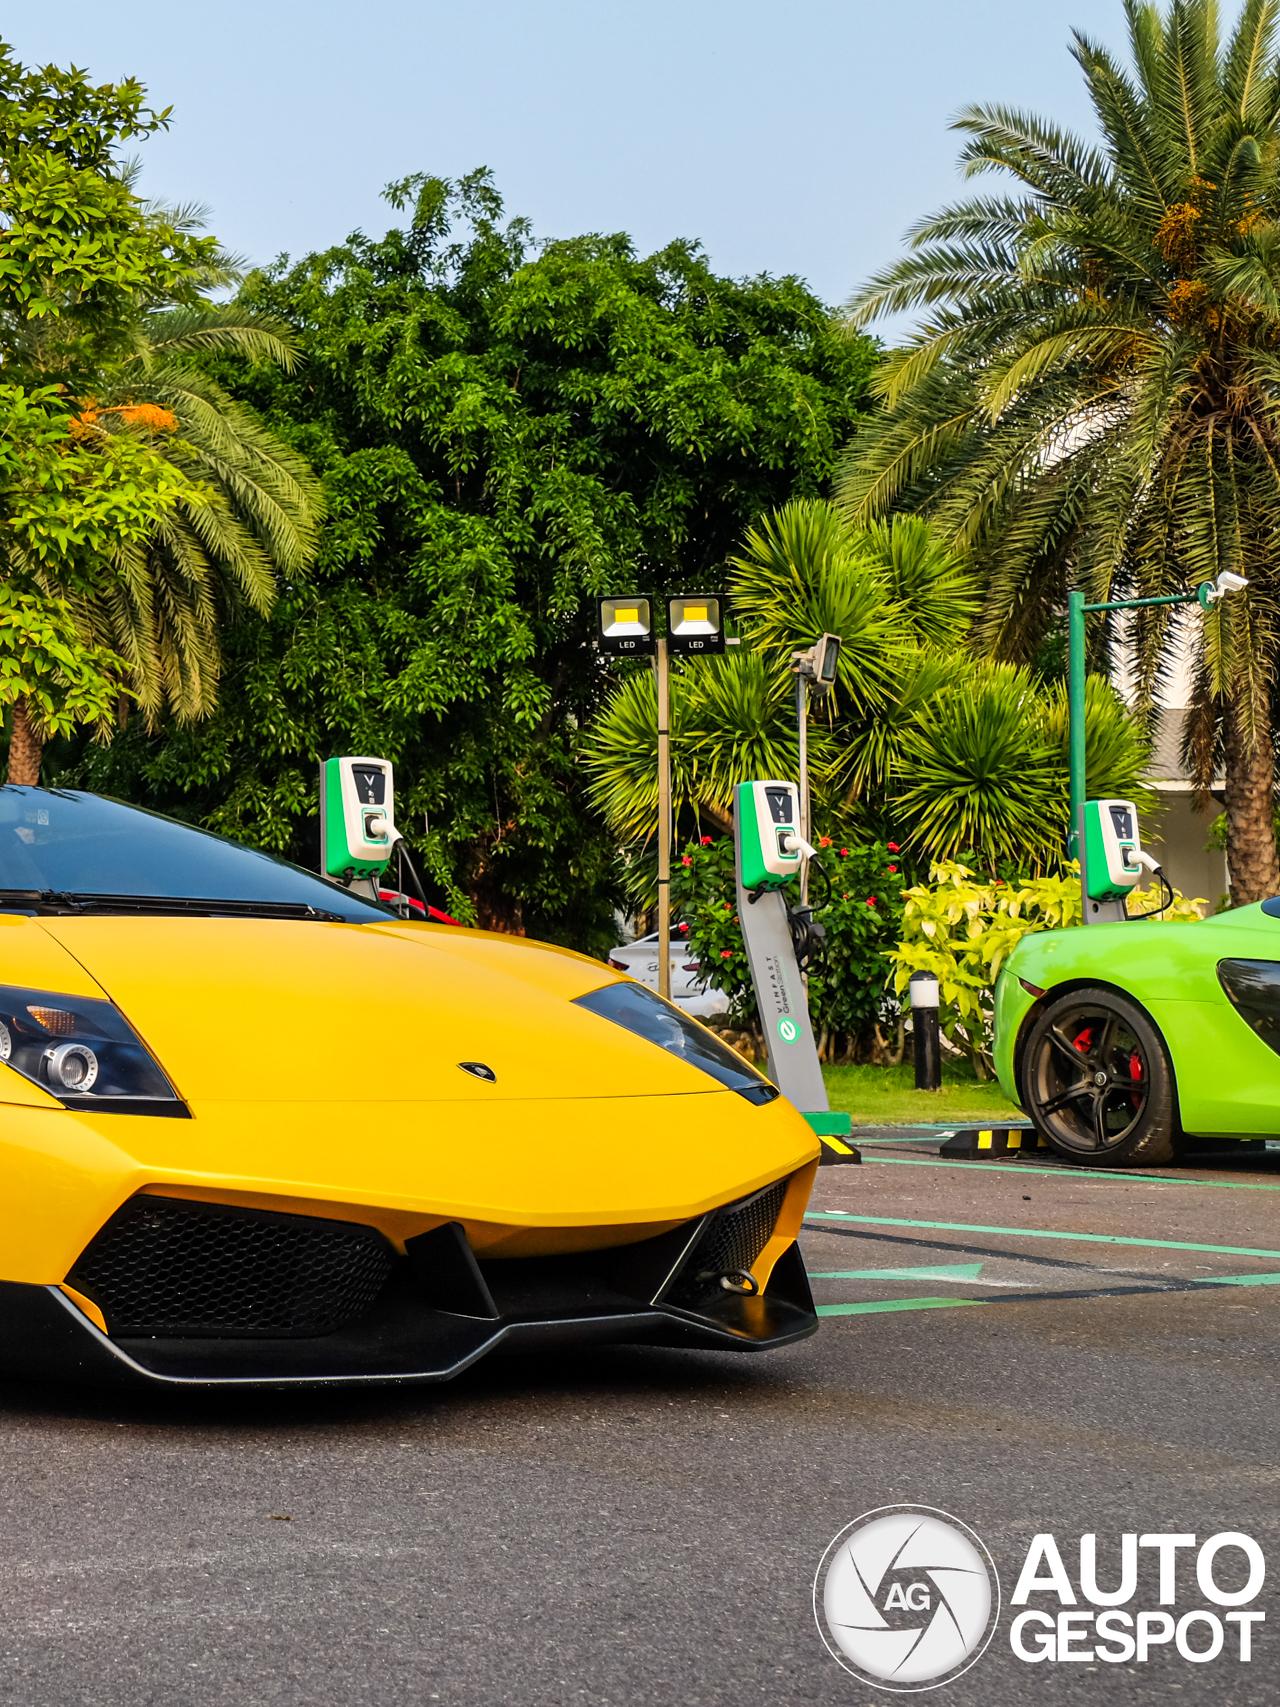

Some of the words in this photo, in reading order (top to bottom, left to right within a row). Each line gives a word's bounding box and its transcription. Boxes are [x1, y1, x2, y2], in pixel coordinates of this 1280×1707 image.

[619, 641, 635, 649] LED
[688, 641, 704, 649] LED
[766, 956, 783, 1013] VINFAST
